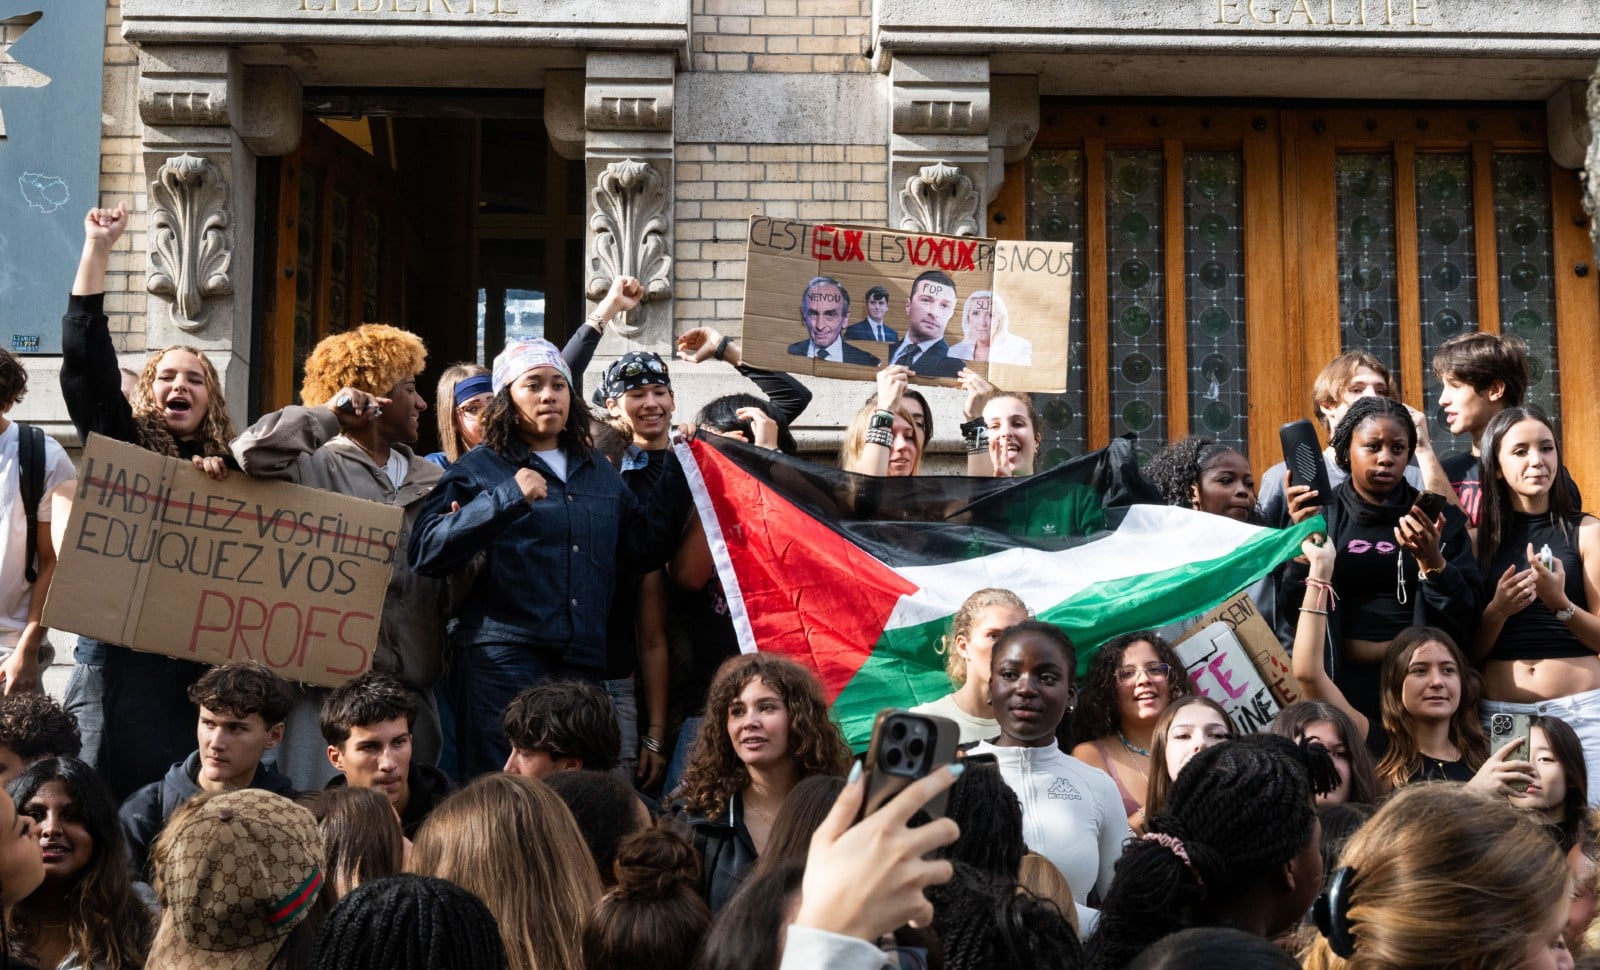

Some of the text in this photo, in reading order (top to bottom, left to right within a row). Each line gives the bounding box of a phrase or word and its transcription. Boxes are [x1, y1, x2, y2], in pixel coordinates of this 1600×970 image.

[751, 217, 813, 255] C'EST
[811, 224, 865, 262] EUX
[867, 232, 907, 263] LES
[923, 284, 943, 295] FDP
[255, 503, 313, 544] VOS
[76, 511, 361, 595] EDUQUEZ VOS
[187, 589, 375, 676] PROFS
